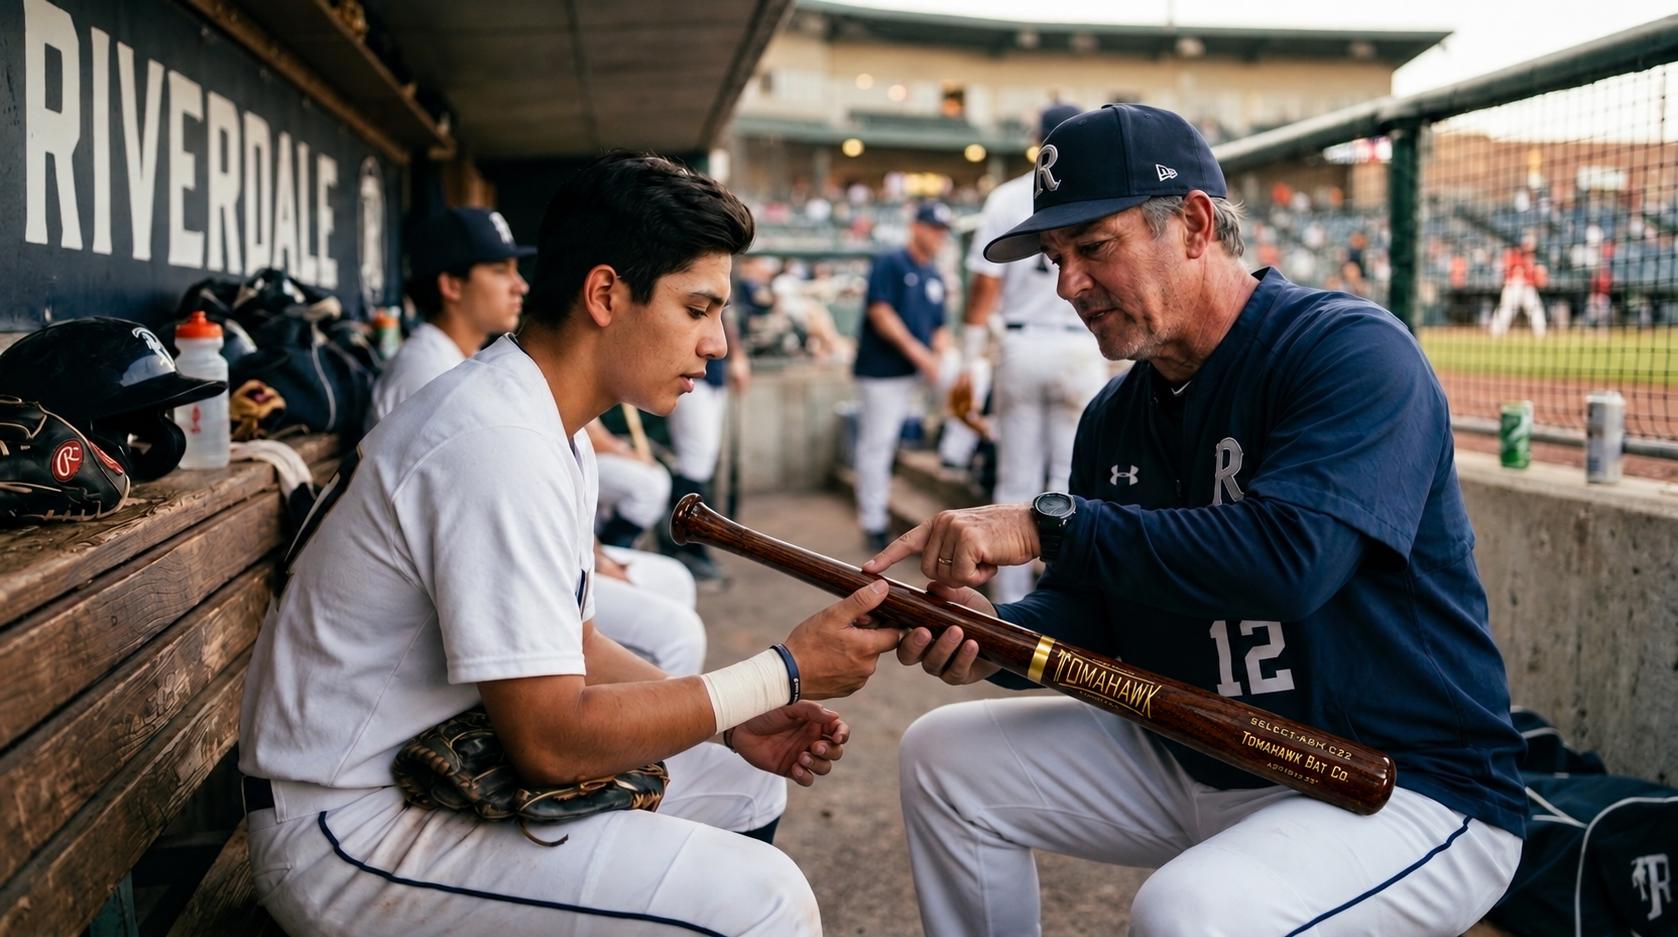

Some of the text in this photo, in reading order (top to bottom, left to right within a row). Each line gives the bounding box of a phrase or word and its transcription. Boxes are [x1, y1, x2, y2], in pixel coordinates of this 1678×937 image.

[24, 0, 338, 289] RIVERDALE
[1034, 144, 1061, 200] R
[1212, 436, 1245, 507] R
[1053, 649, 1163, 719] TOMAHAWK
[1208, 619, 1296, 698] 12
[1241, 730, 1304, 765] TOMAHAWK
